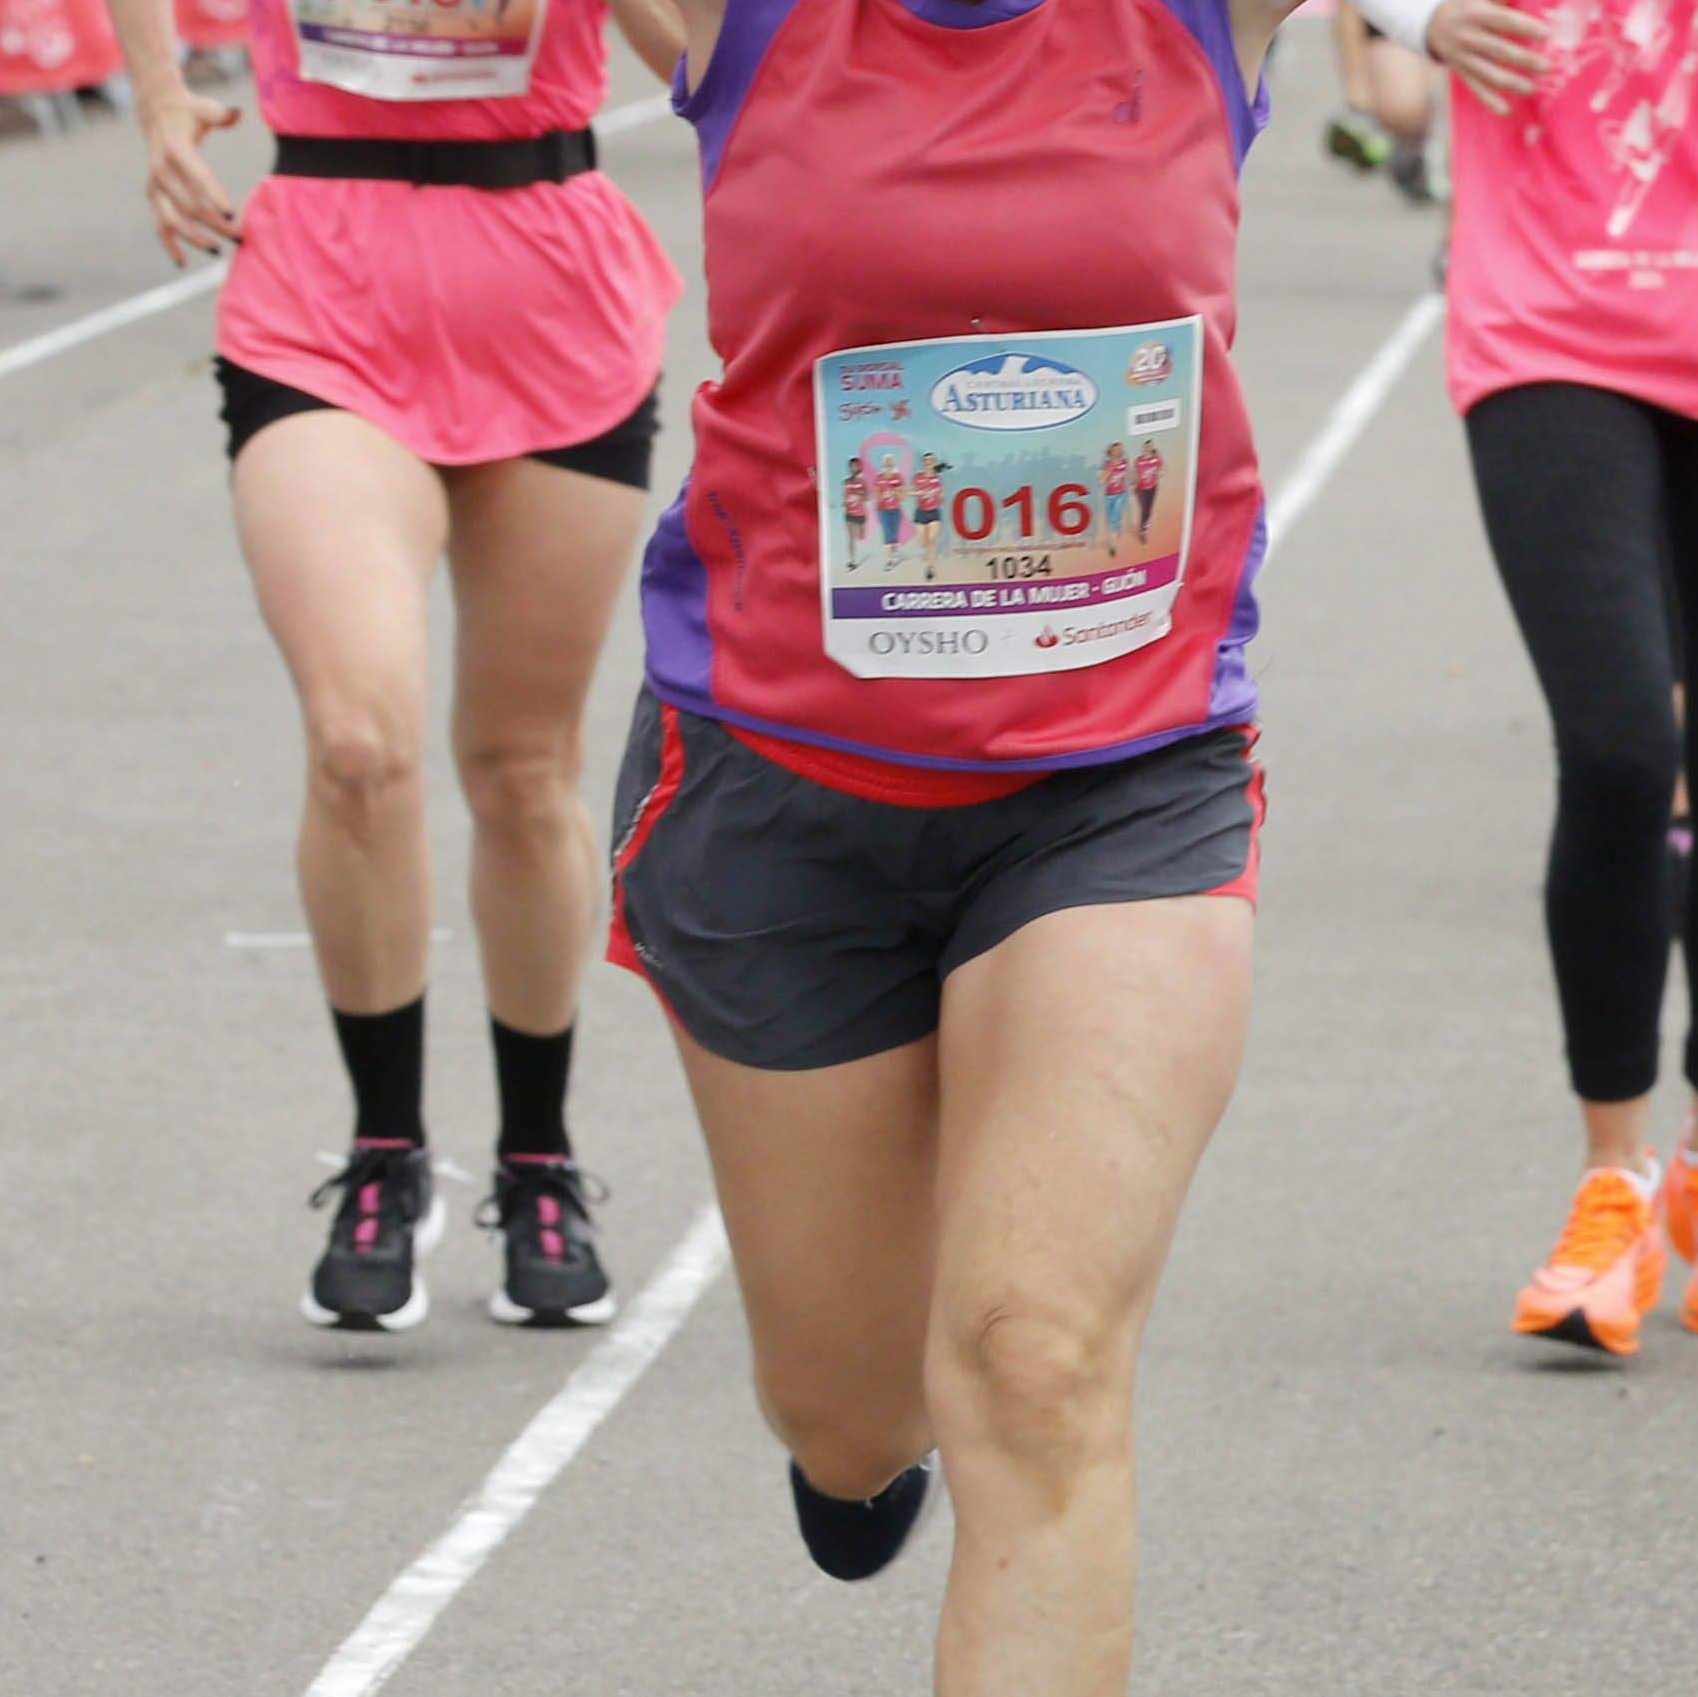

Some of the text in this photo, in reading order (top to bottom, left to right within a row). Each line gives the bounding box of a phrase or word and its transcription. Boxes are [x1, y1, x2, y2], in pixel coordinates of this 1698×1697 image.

[942, 381, 1086, 412] ASTURIANA
[952, 483, 1092, 541] 016
[984, 554, 1053, 581] 1034
[881, 589, 969, 612] CARRERA
[972, 588, 997, 609] DE
[1000, 586, 1025, 607] LA
[1028, 579, 1091, 605] MUJER
[1101, 567, 1148, 596] GIJÓN
[868, 629, 989, 655] OYSHO
[1061, 609, 1152, 647] Santander
